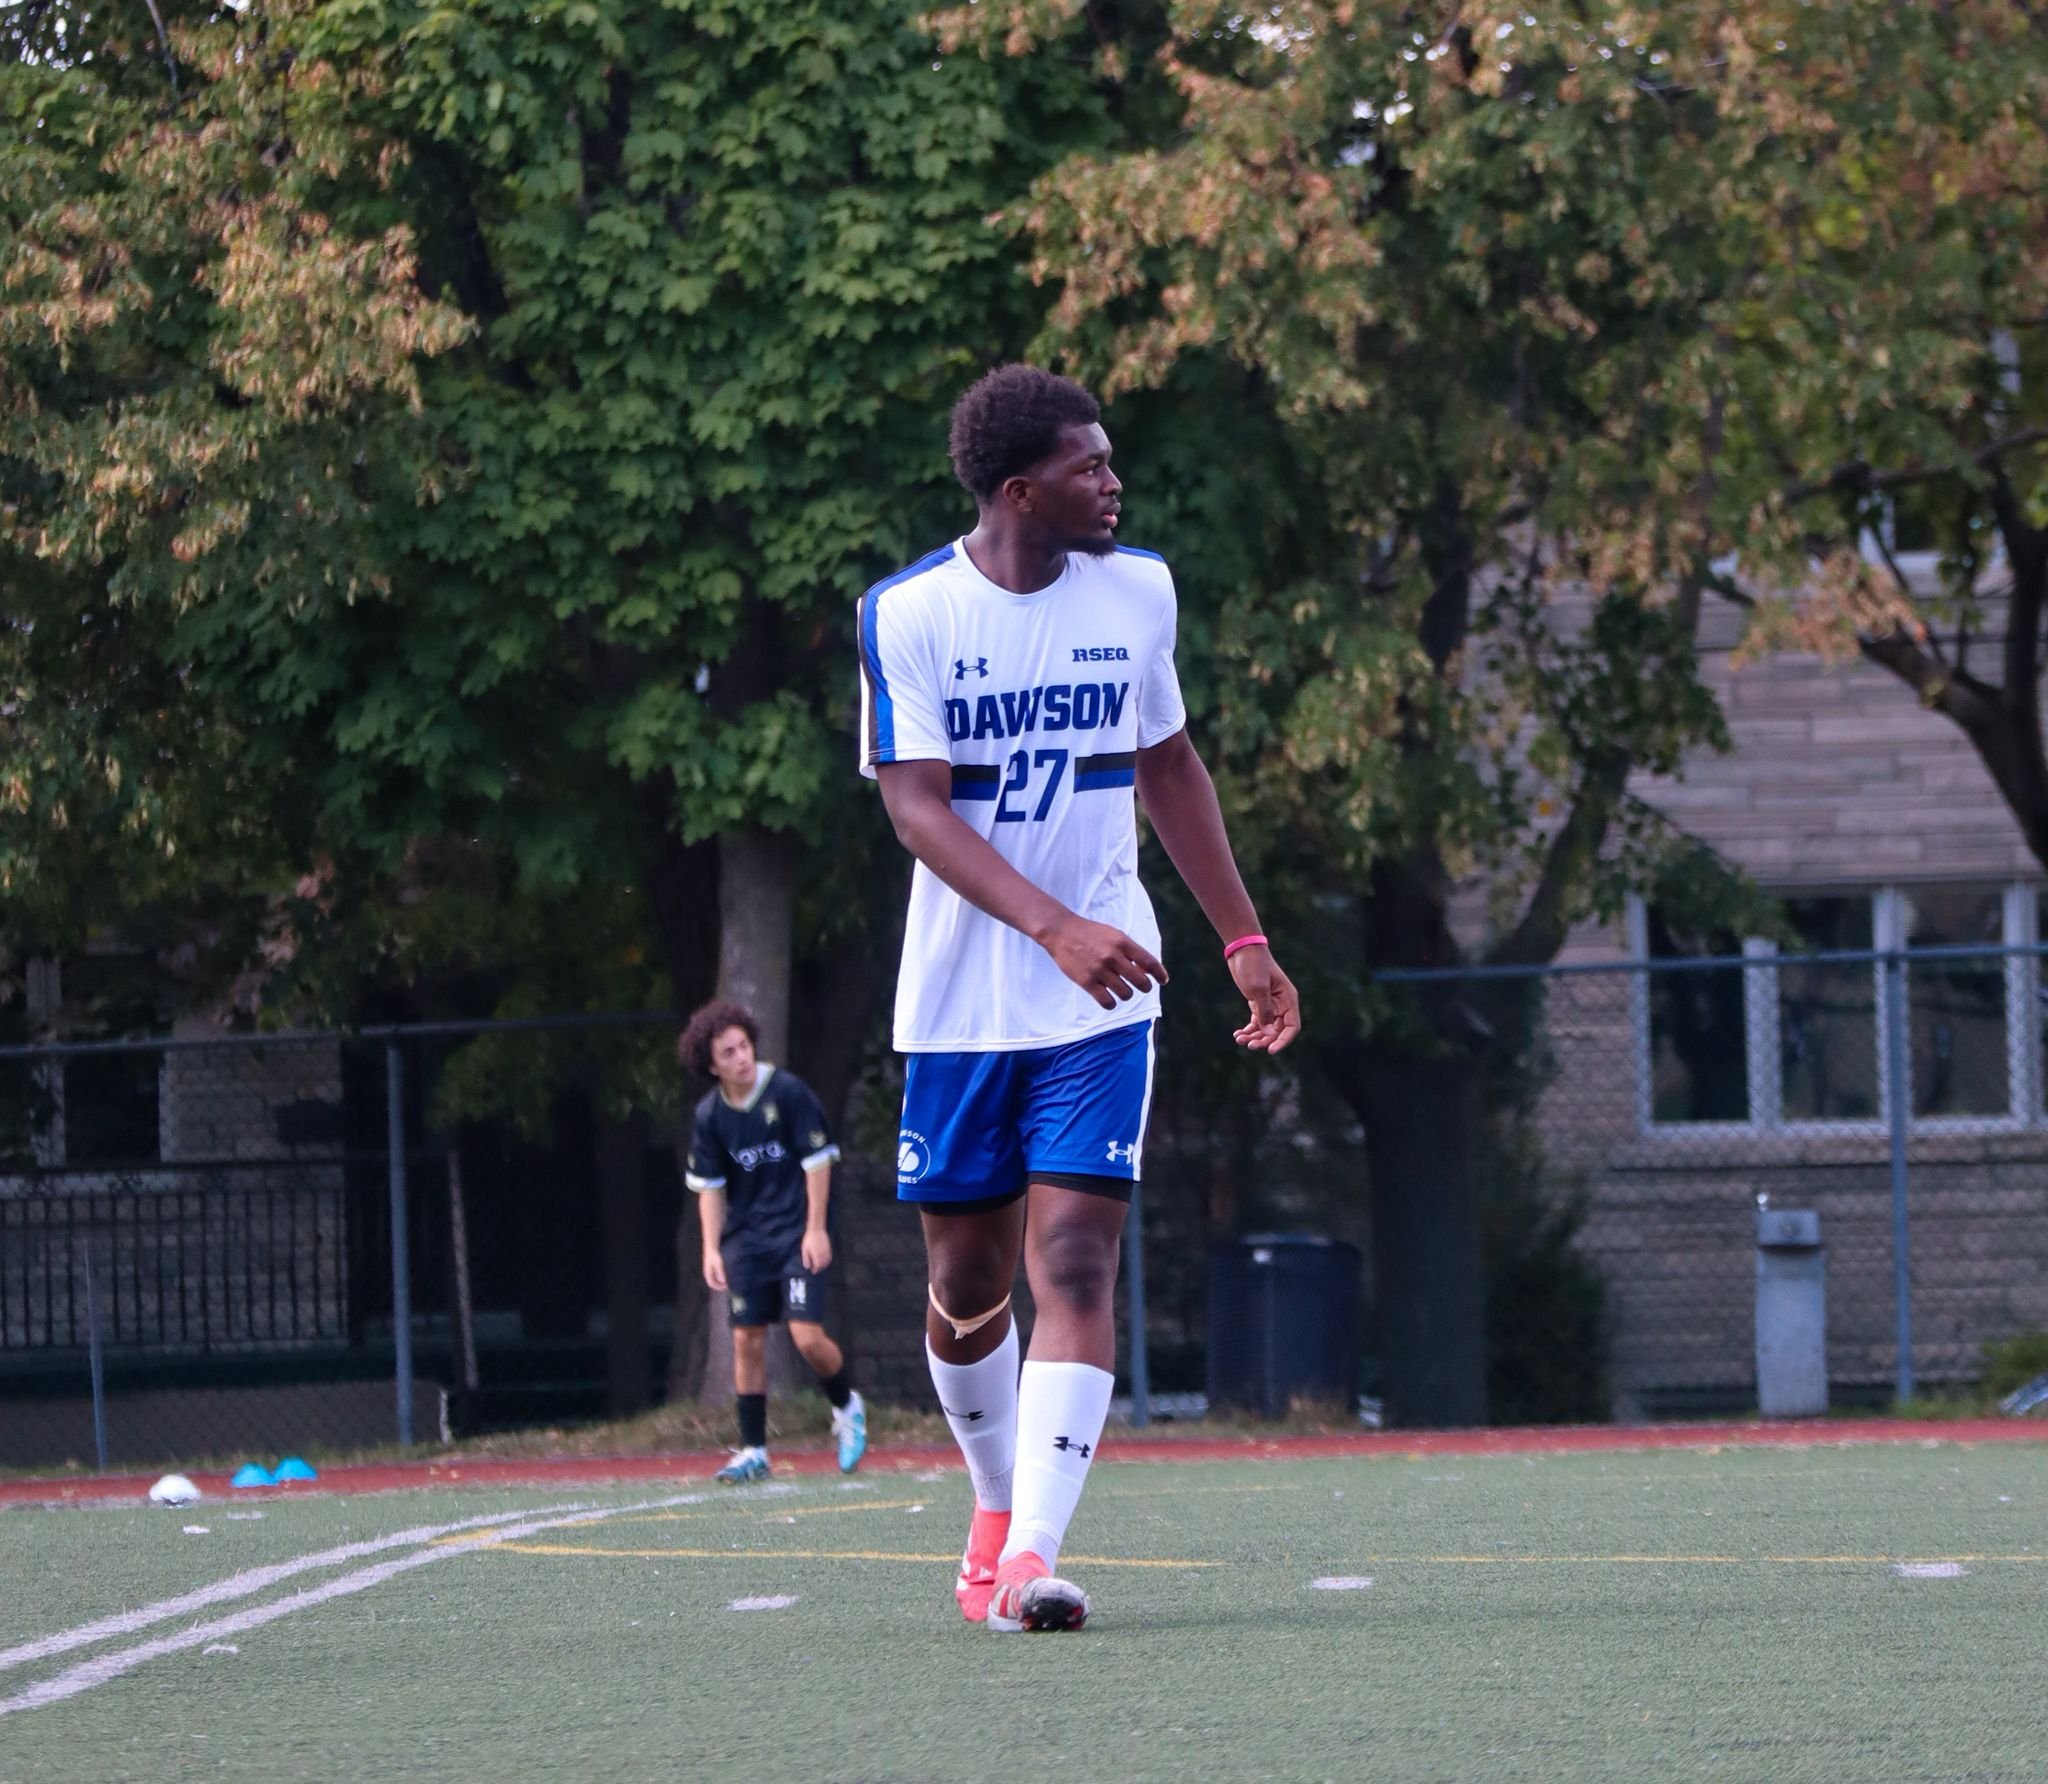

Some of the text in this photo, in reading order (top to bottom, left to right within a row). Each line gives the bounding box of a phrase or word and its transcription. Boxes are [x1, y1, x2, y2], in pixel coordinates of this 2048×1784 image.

[1072, 648, 1130, 662] RSEQ
[944, 682, 1129, 742] DAWSON
[995, 749, 1069, 823] 27
